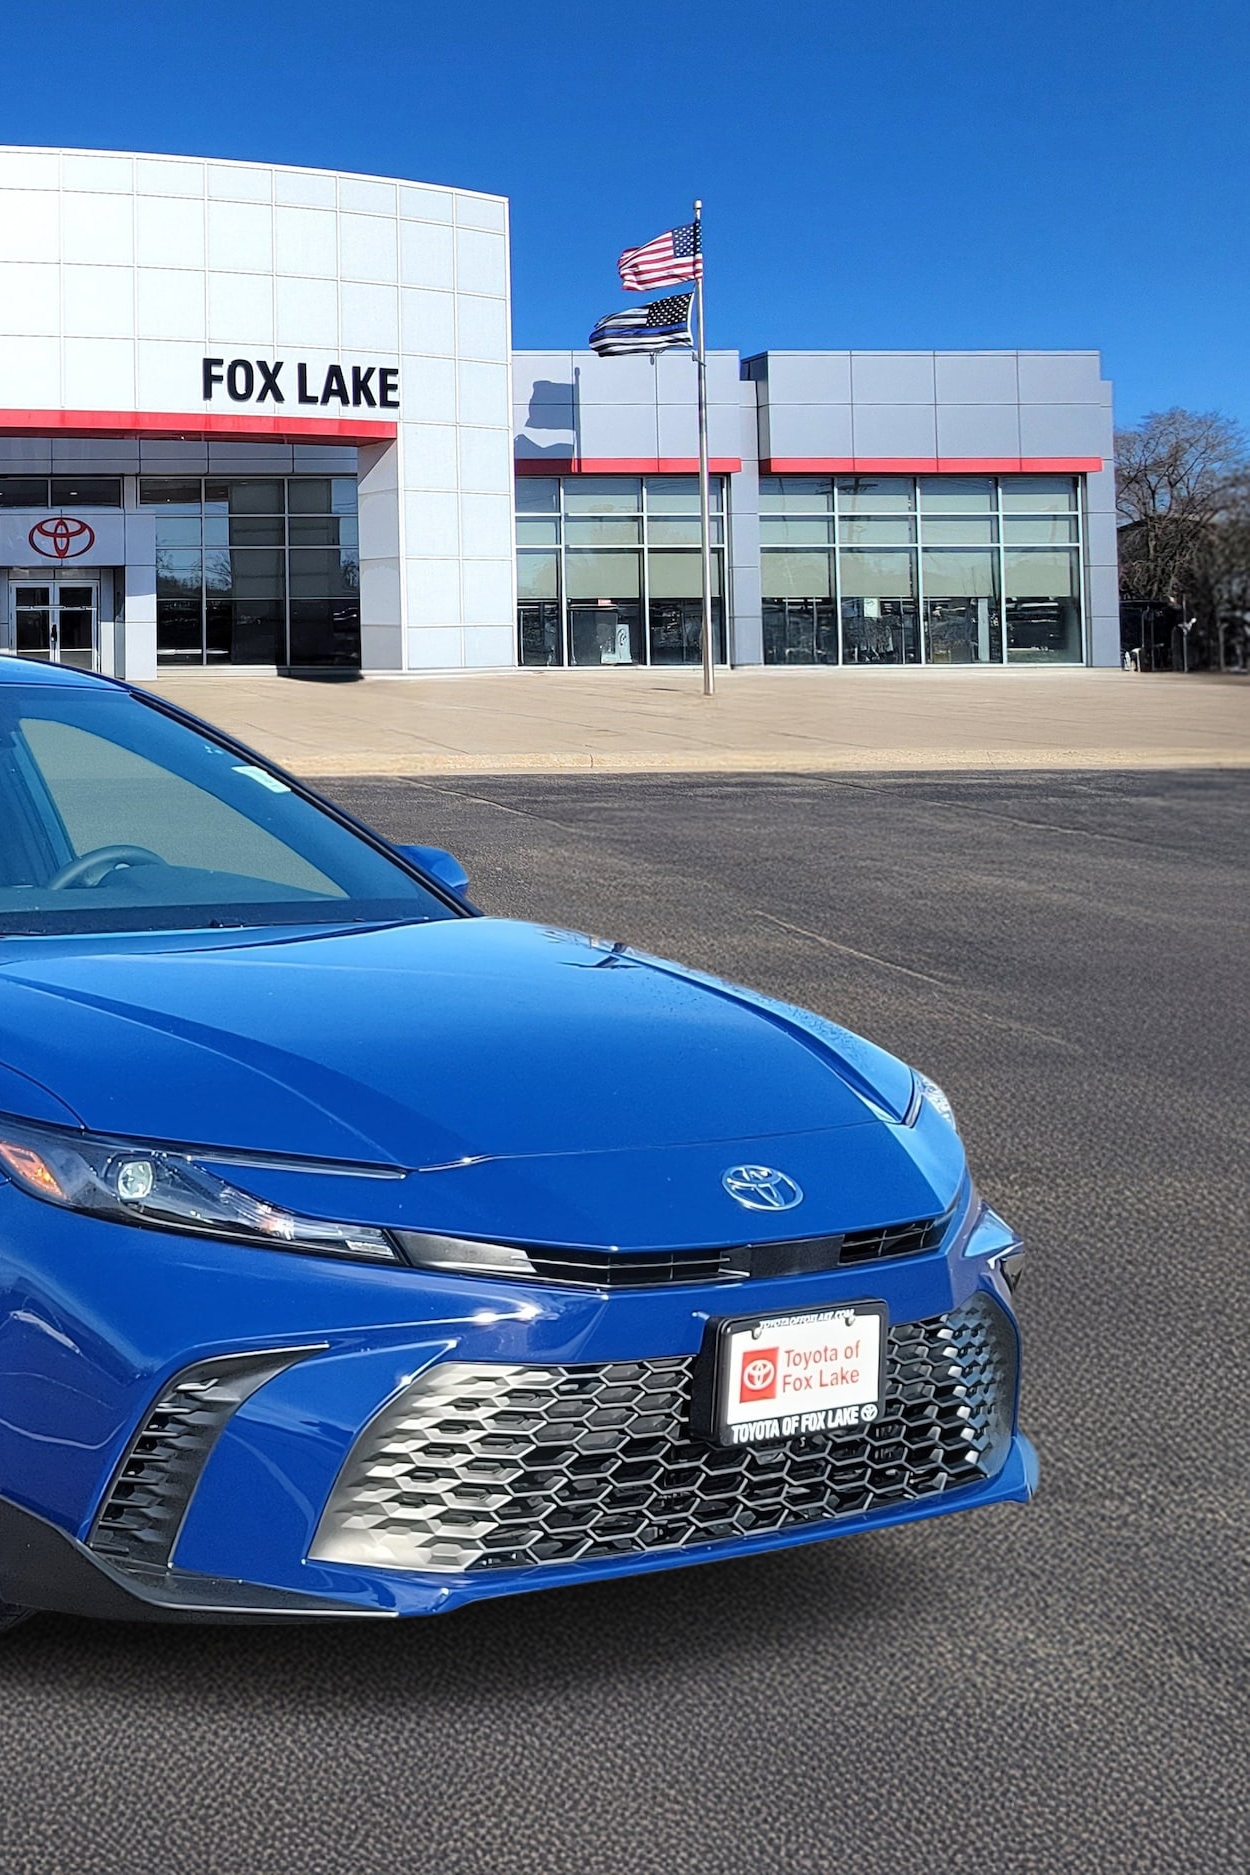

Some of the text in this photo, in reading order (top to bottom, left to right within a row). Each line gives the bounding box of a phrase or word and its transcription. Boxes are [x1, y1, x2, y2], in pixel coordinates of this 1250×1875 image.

[202, 357, 400, 408] FOX LAKE
[784, 1340, 861, 1370] Toyota of
[782, 1367, 860, 1393] Fox Lake
[731, 1406, 860, 1444] TOYOTA OF FOX LAKE
